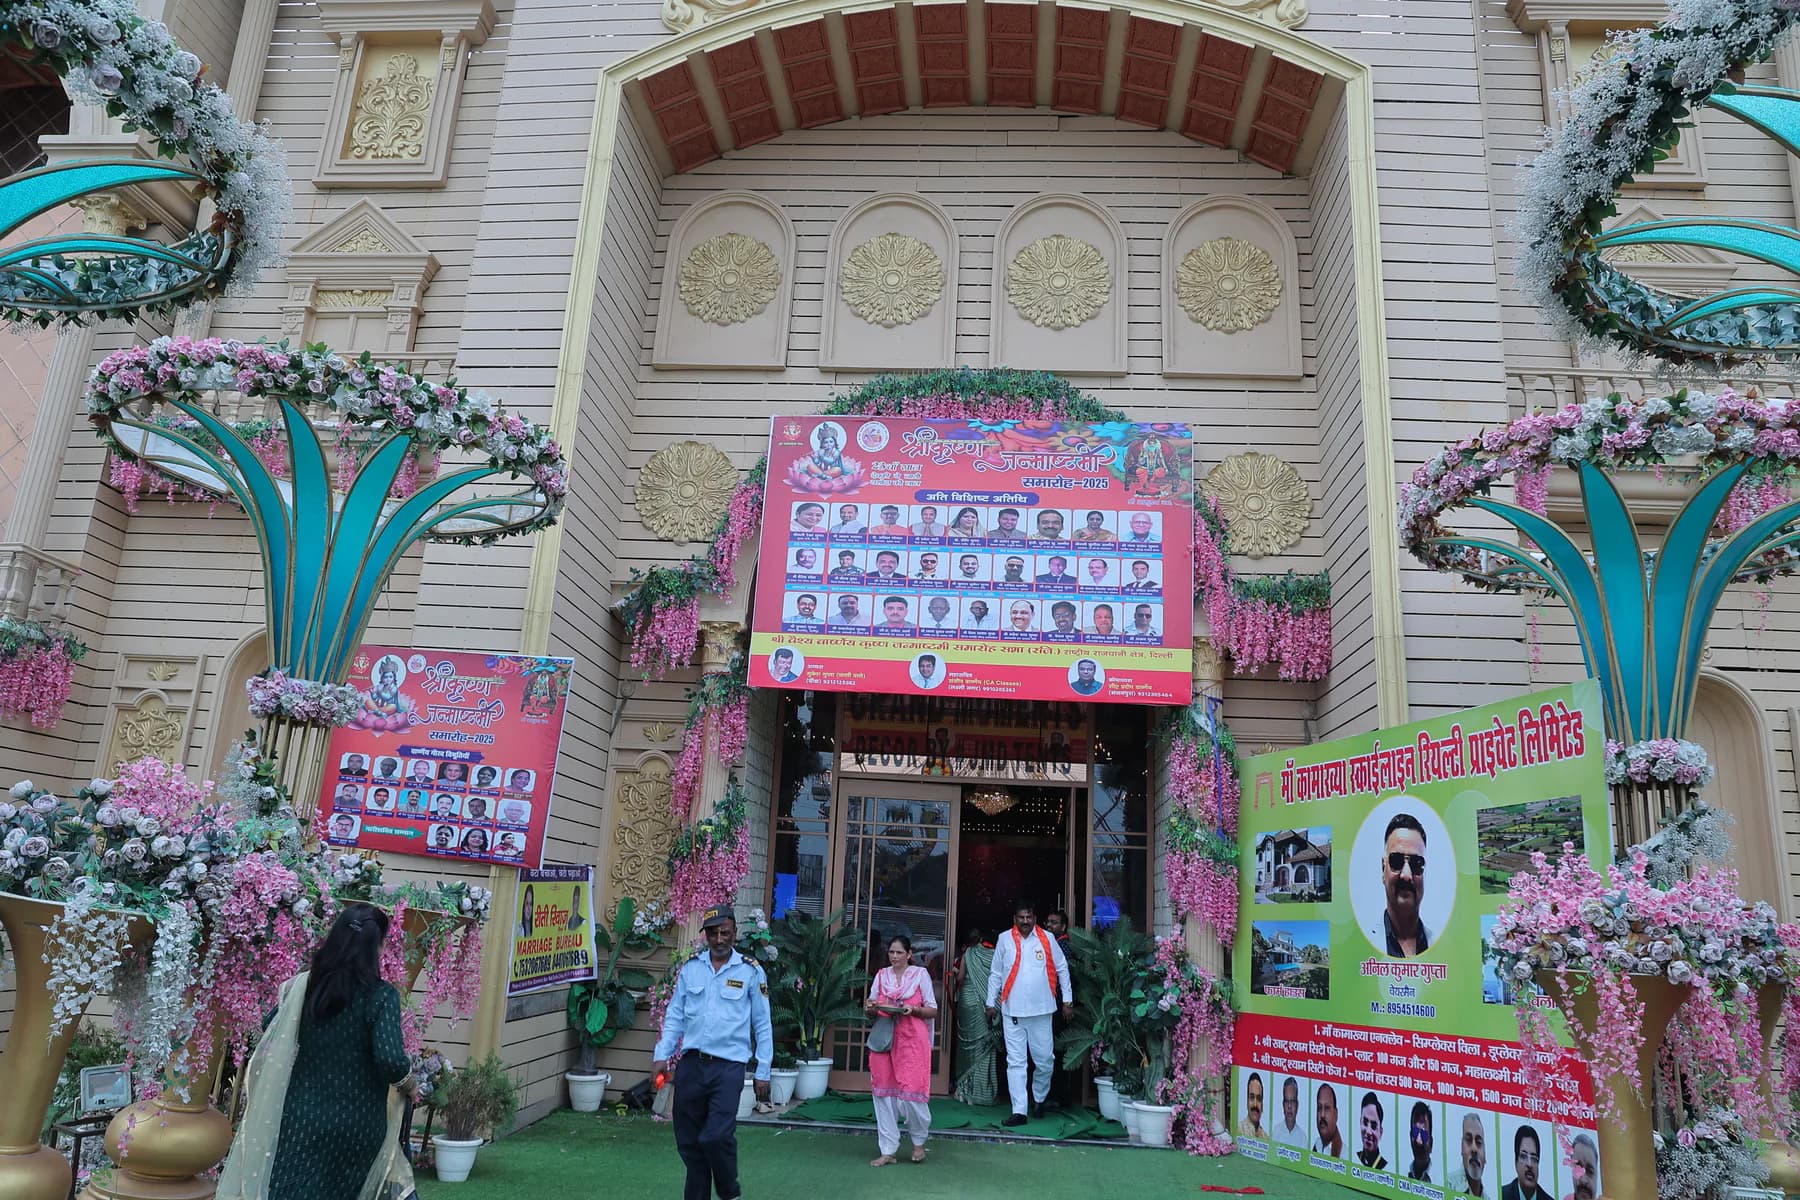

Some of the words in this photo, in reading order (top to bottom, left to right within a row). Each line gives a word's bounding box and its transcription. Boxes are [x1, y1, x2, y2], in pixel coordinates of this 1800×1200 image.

[974, 443, 1117, 472] जन्माष्टमी
[926, 491, 948, 502] अति
[951, 492, 990, 503] विशिष्ट
[992, 494, 1028, 505] अतिथि
[771, 635, 785, 644] श्री
[788, 635, 813, 645] वैश्य
[816, 636, 856, 647] वार्ष्णेय
[859, 639, 889, 650] कृष्ण
[892, 640, 950, 651] जन्माष्टमी
[952, 643, 997, 653] समारोह
[1000, 645, 1024, 655] सभा
[1150, 651, 1174, 660] दिल्ली
[1296, 758, 1348, 803] कामाख्या
[1349, 740, 1416, 797] स्काईलाइन
[1417, 722, 1465, 784] रियल्टी
[1468, 716, 1517, 782] प्राइवेट
[1518, 699, 1585, 767] लिमिटेड
[516, 937, 553, 957] MARRIAGE
[555, 933, 583, 951] BUREAU
[1360, 957, 1389, 977] अनिल
[1391, 963, 1419, 982] कुमार
[1421, 964, 1448, 985] गुप्ता
[1387, 1003, 1436, 1018] 8954514600
[1333, 1027, 1369, 1041] कामाख्या
[1261, 1034, 1271, 1048] श्री
[1308, 1040, 1326, 1056] सिटी
[1376, 1051, 1389, 1065] 100
[1389, 1055, 1407, 1068] गज
[1407, 1054, 1426, 1070] और
[1427, 1058, 1440, 1071] 150
[1260, 1052, 1271, 1066] श्री
[1307, 1058, 1325, 1074] सिटी
[1375, 1072, 1398, 1087] हाउस
[1398, 1074, 1412, 1089] 500
[1437, 1081, 1455, 1097] 1000
[1481, 1089, 1501, 1104] 1500
[1502, 1093, 1522, 1109] गज
[1351, 1167, 1362, 1178] CA
[1398, 1180, 1411, 1192] CMA
